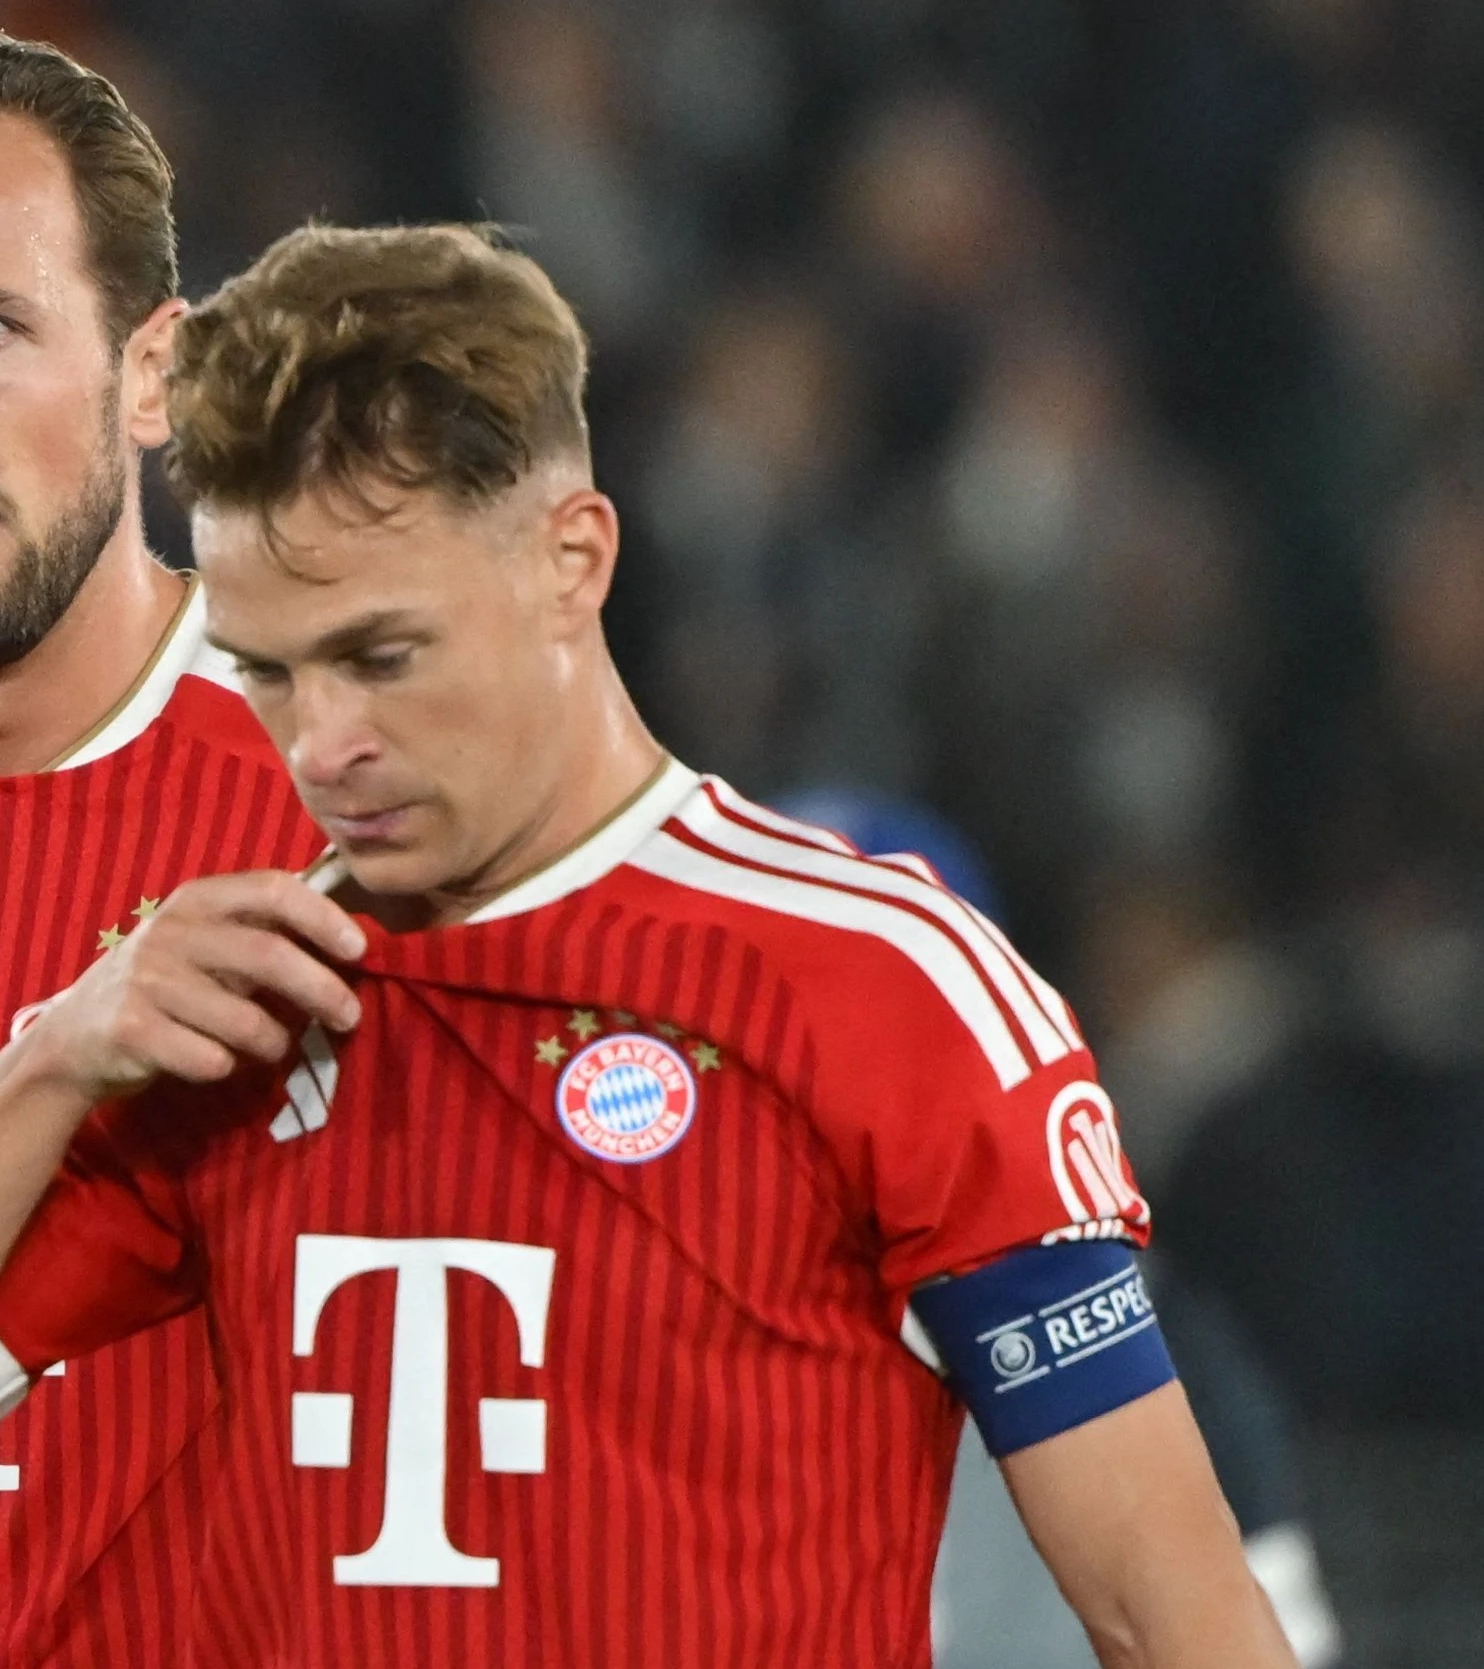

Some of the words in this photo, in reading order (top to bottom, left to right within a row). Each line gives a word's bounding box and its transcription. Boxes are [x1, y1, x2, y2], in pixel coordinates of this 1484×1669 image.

[571, 1060, 598, 1091] FC
[598, 1042, 686, 1092] BAYERN
[292, 1234, 557, 1588] T
